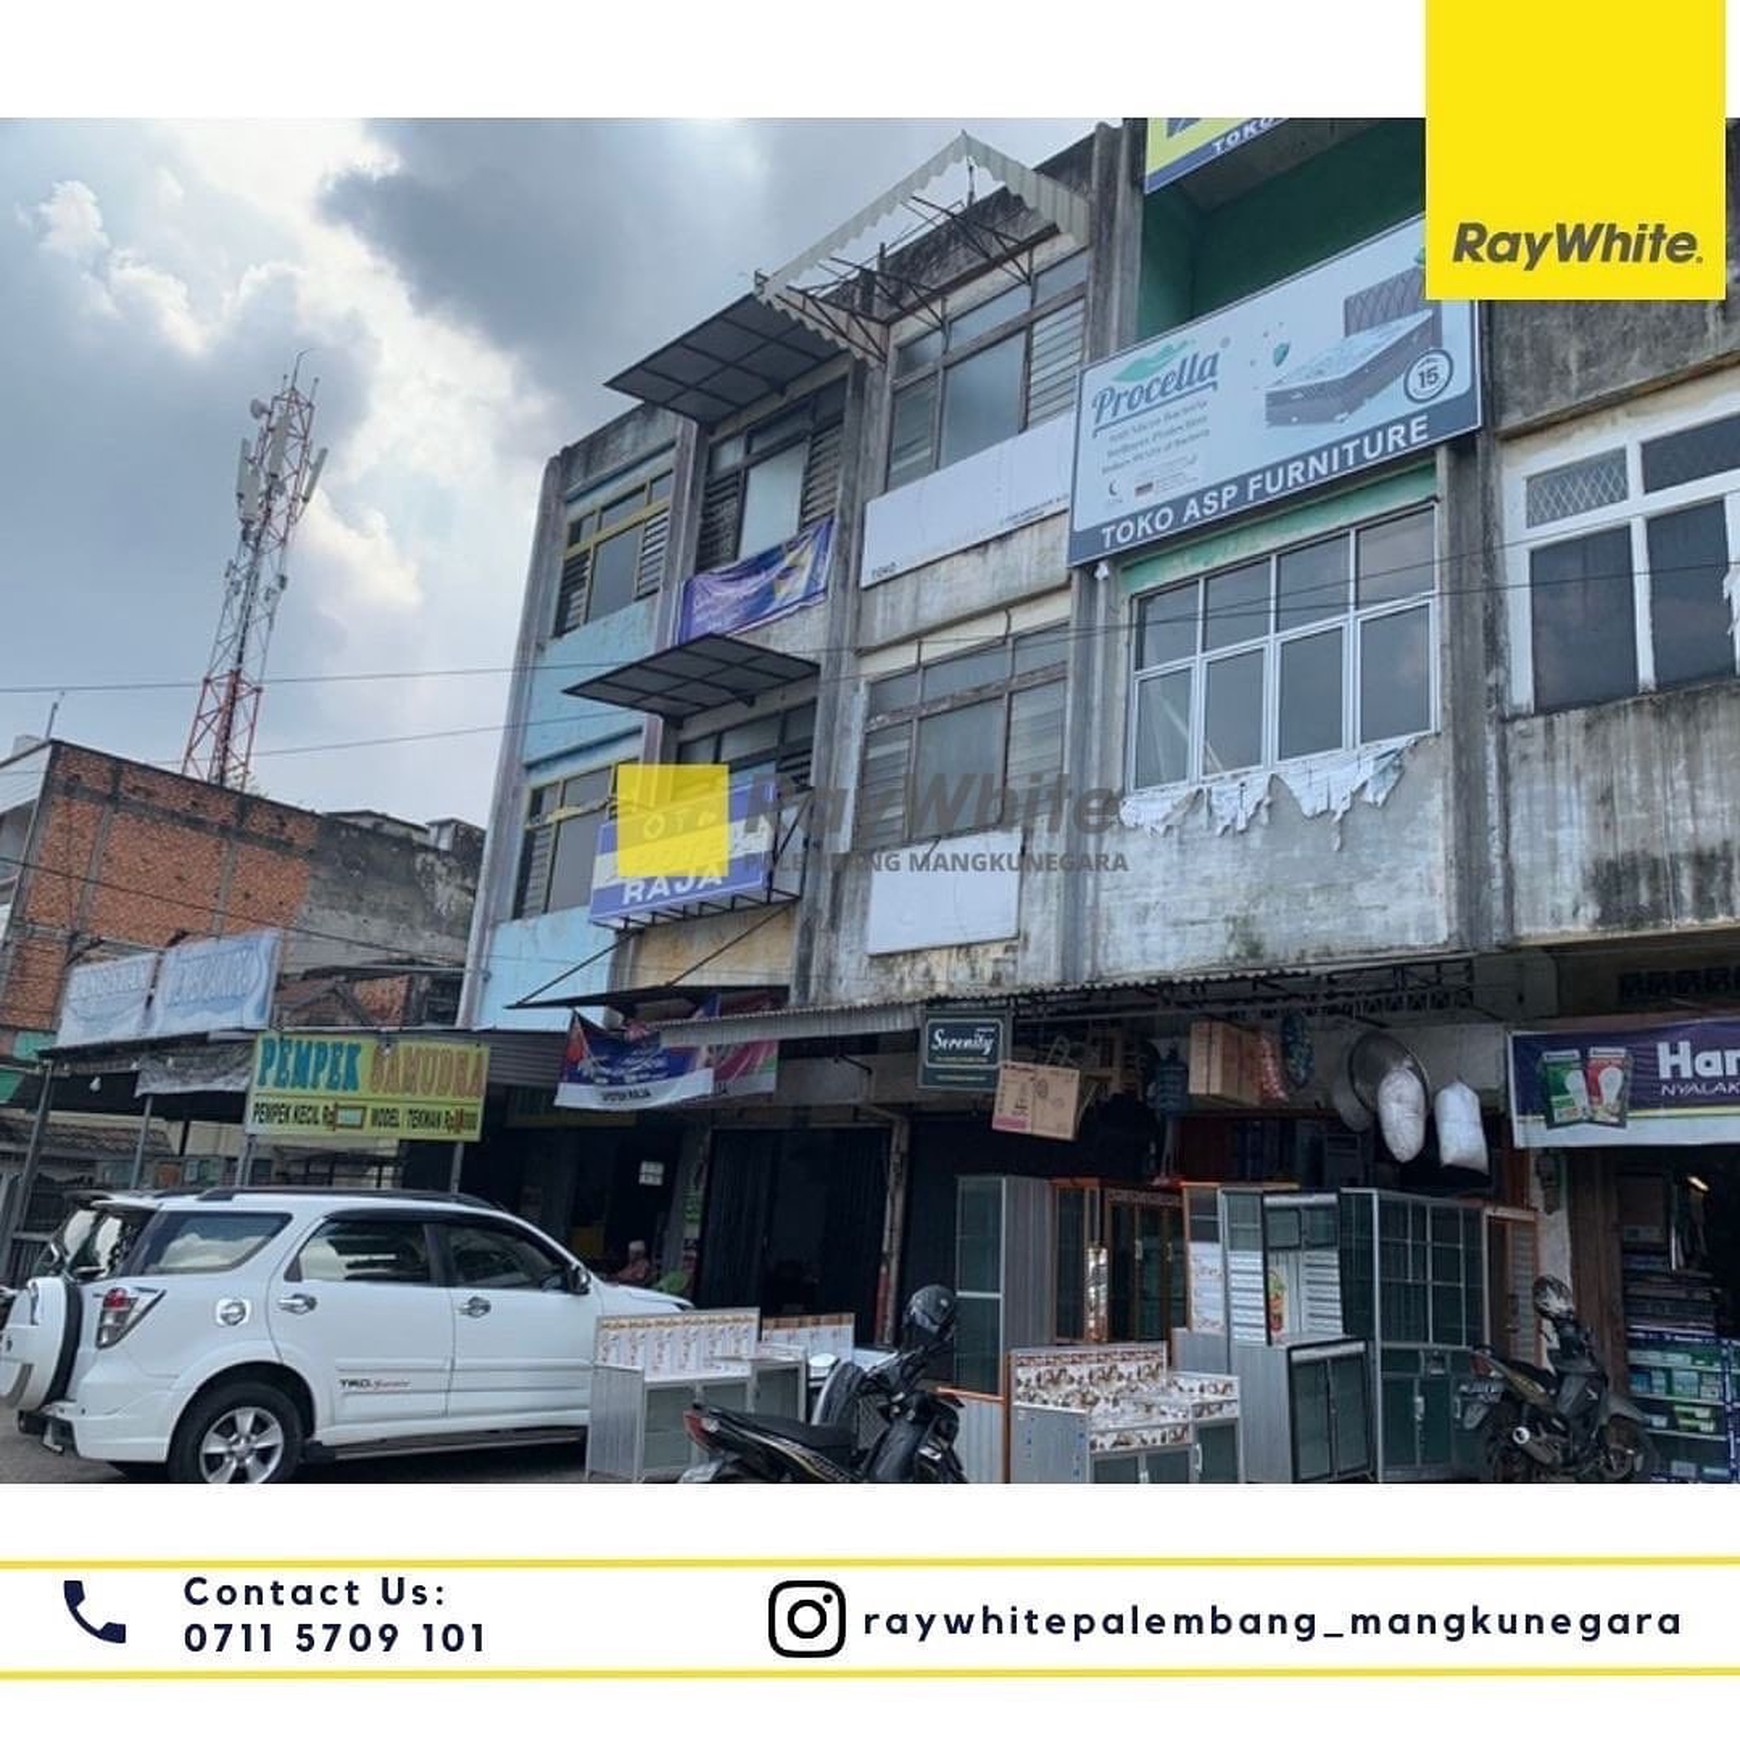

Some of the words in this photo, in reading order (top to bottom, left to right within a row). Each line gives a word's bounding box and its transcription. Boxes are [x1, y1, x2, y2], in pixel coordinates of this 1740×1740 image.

[1091, 351, 1220, 426] Procella
[1418, 365, 1440, 389] 15
[1101, 506, 1173, 549] TOKO
[1183, 484, 1239, 525] ASP
[1248, 413, 1429, 501] FURNITURE
[622, 862, 723, 905] RAJA
[256, 1036, 362, 1092] PEMPEK
[931, 1027, 995, 1056] Serenity
